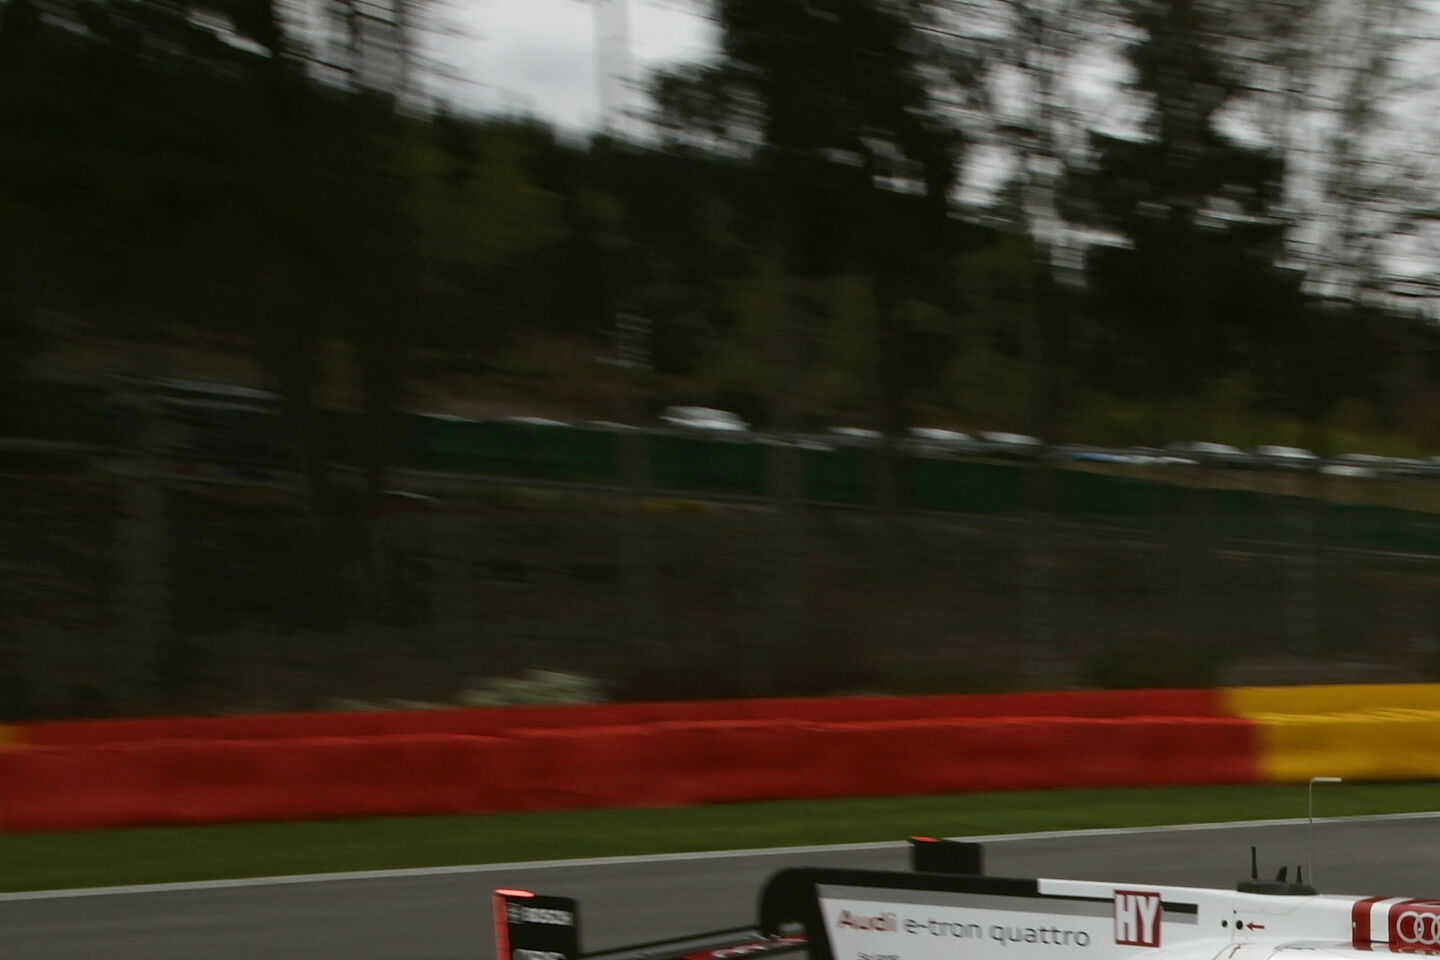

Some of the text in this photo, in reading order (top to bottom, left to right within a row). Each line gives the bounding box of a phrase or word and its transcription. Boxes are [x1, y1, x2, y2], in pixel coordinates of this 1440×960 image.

[837, 909, 1090, 948] Audi e-tron quattro
[1114, 893, 1160, 945] HY
